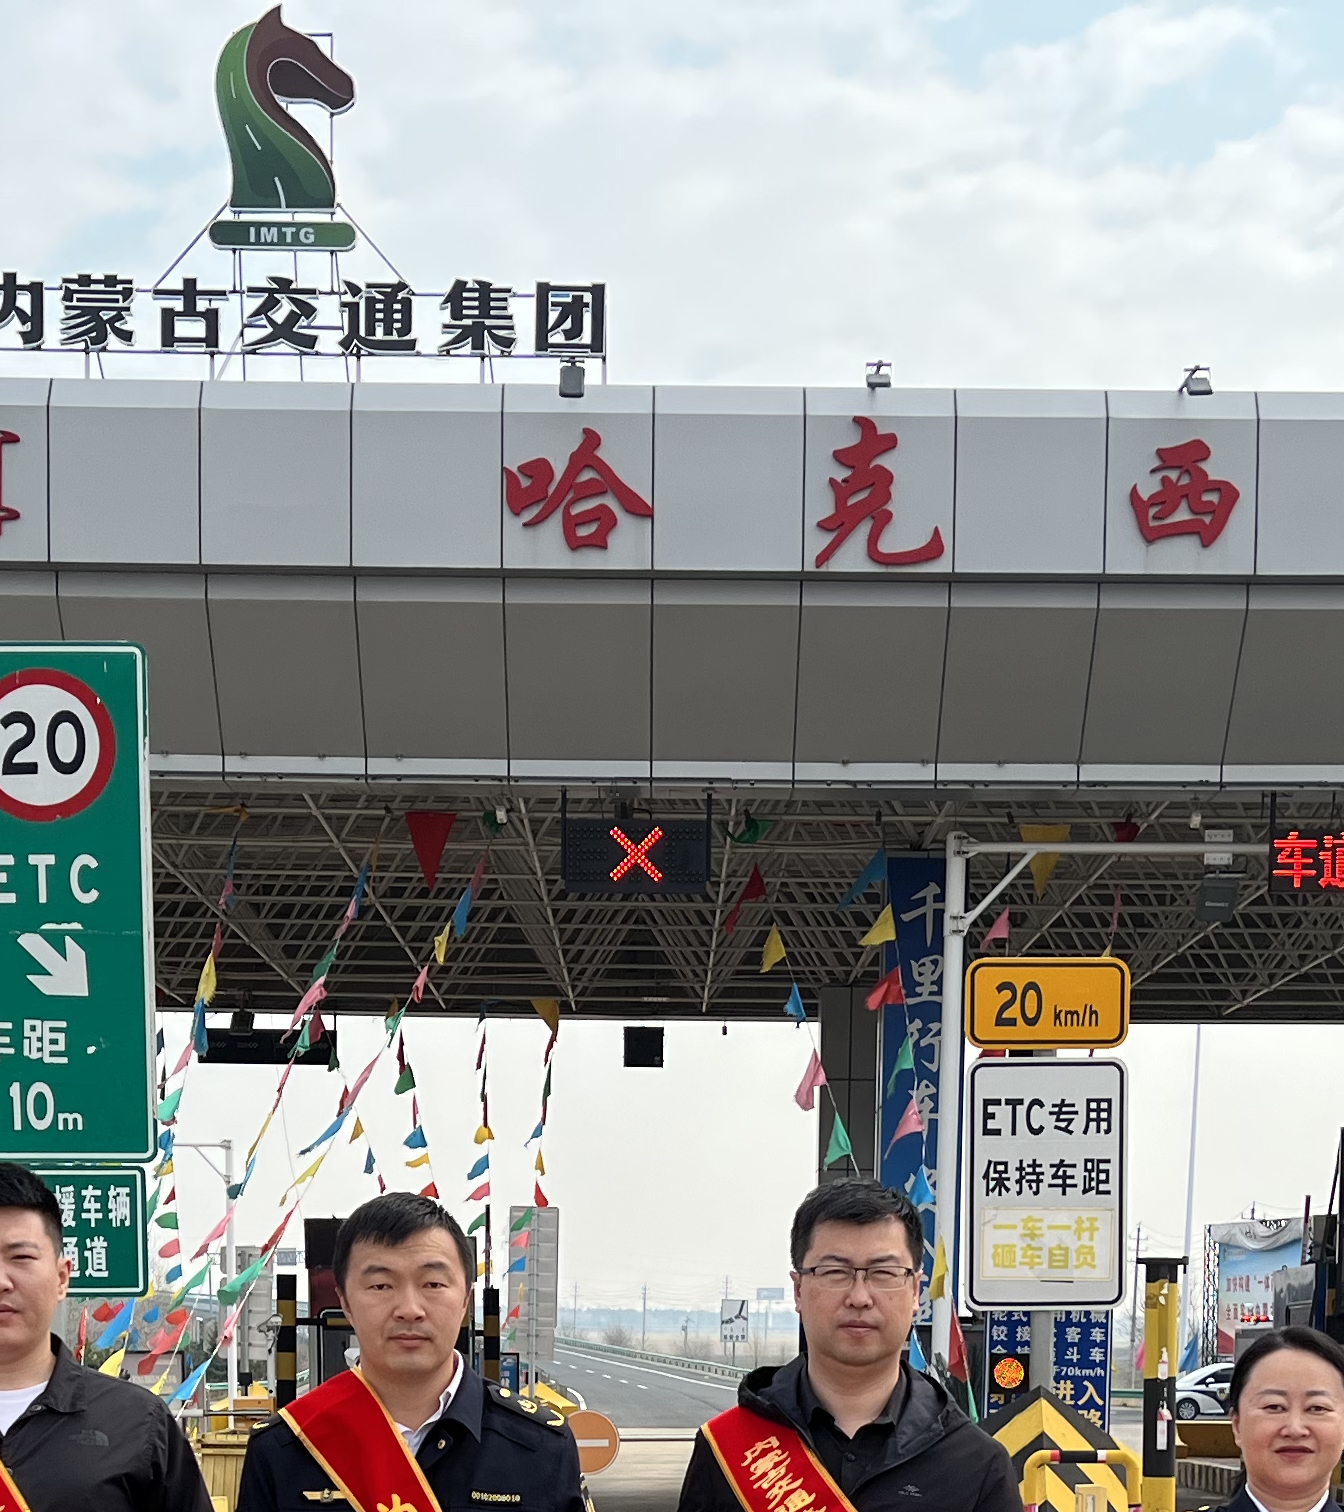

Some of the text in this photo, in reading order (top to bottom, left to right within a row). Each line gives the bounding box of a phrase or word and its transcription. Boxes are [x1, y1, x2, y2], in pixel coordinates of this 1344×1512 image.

[249, 227, 315, 244] IMTG
[0, 710, 86, 775] 20
[994, 980, 1099, 1028] 20 km/h
[9, 1081, 83, 1132] 10m
[982, 1098, 1112, 1137] ETC专用
[982, 1158, 1111, 1197] 保持车距
[992, 1215, 1100, 1241] 一车一杆
[61, 1236, 109, 1277] 通道
[991, 1244, 1096, 1270] 砸车自负
